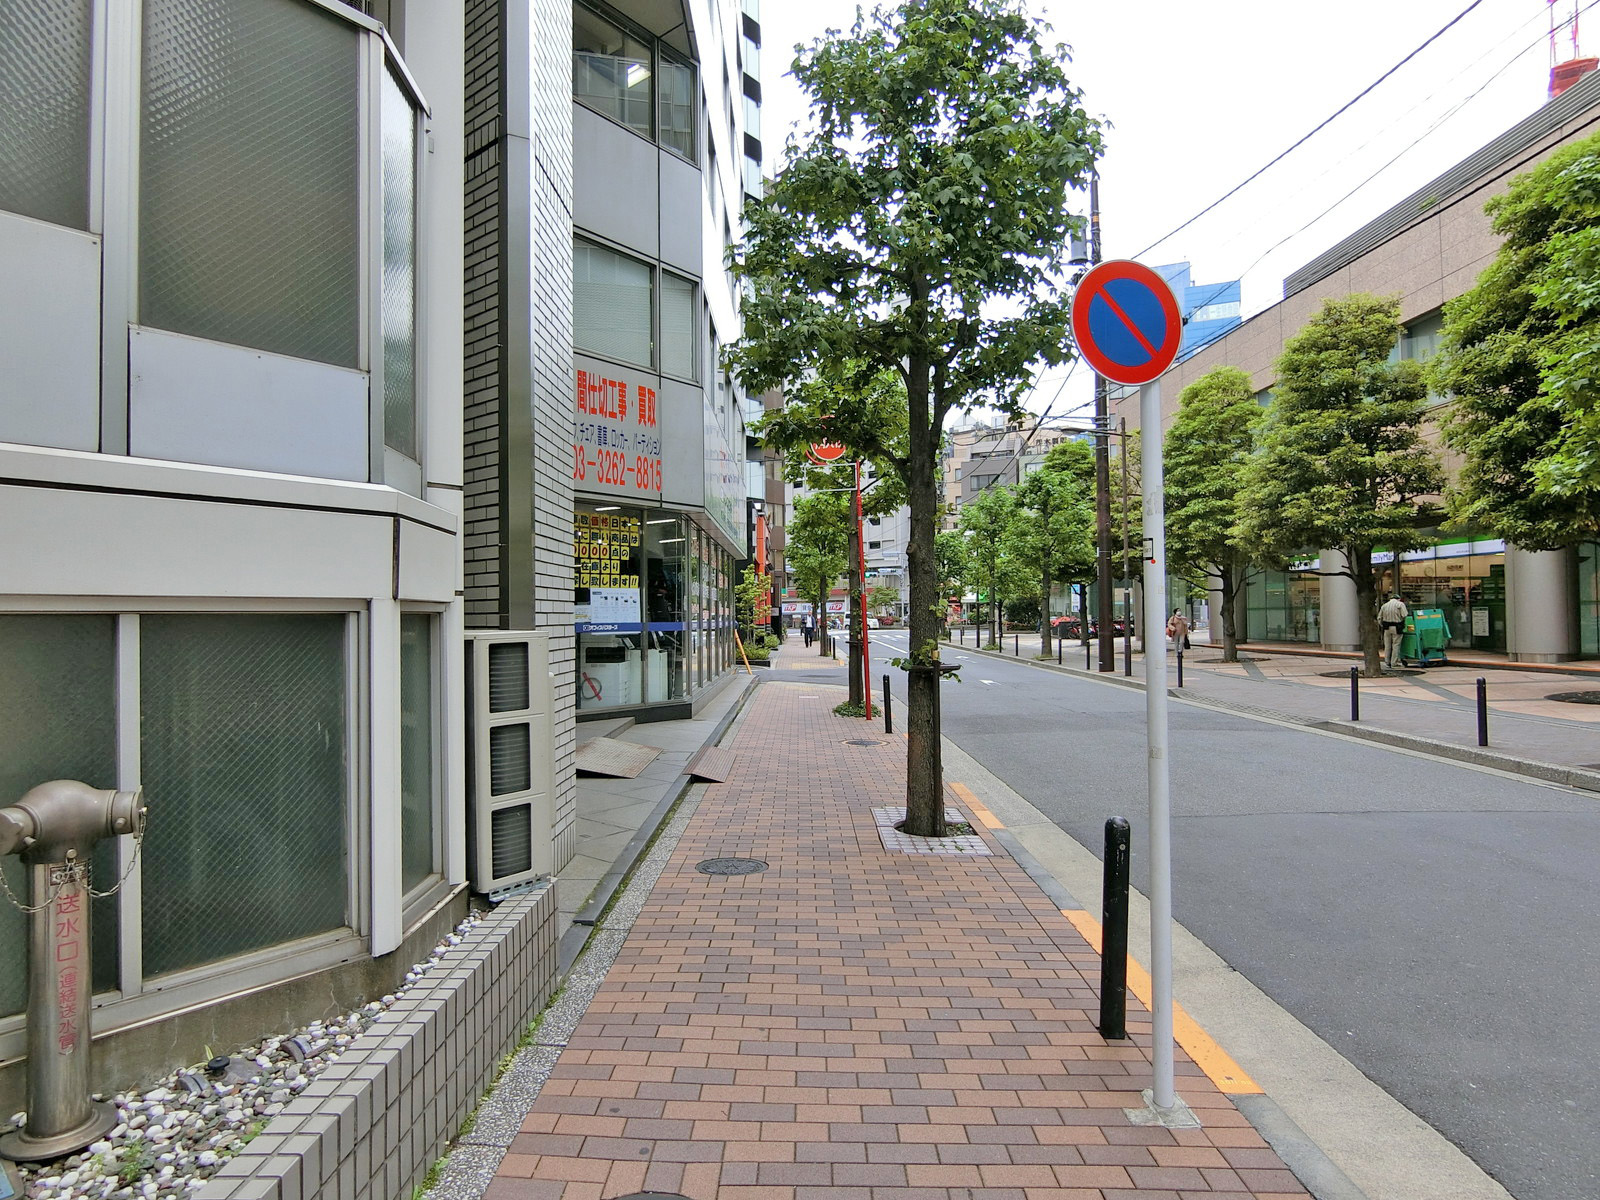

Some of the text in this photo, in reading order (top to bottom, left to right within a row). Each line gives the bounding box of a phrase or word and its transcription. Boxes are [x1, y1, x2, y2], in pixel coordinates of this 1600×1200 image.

[577, 369, 656, 428] 間仕切工事・買取
